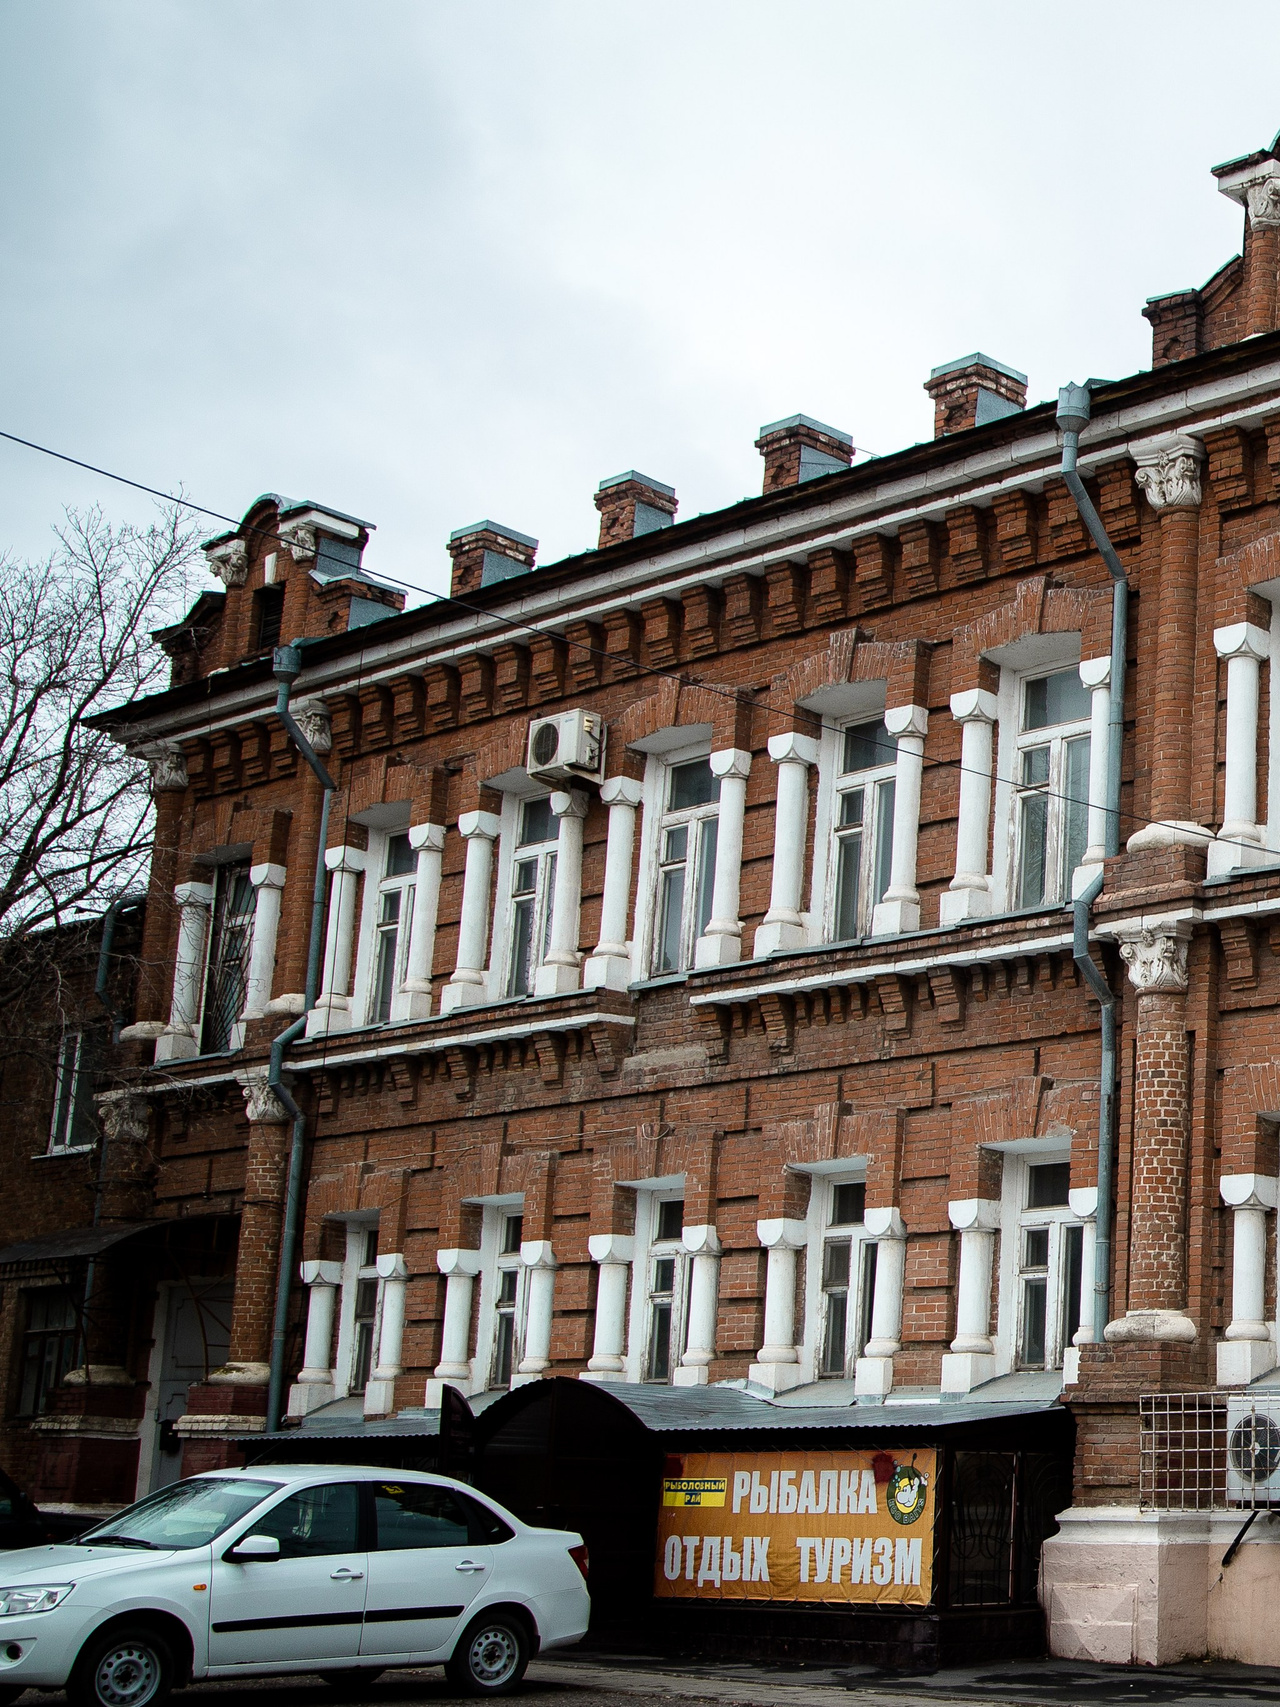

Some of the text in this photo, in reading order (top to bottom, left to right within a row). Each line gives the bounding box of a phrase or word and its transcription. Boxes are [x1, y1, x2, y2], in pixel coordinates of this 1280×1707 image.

[685, 1493, 701, 1504] РАЙ
[732, 1469, 878, 1515] РЫБАЛКА
[663, 1535, 923, 1588] ОТДЫХ ТУРИЗМ
